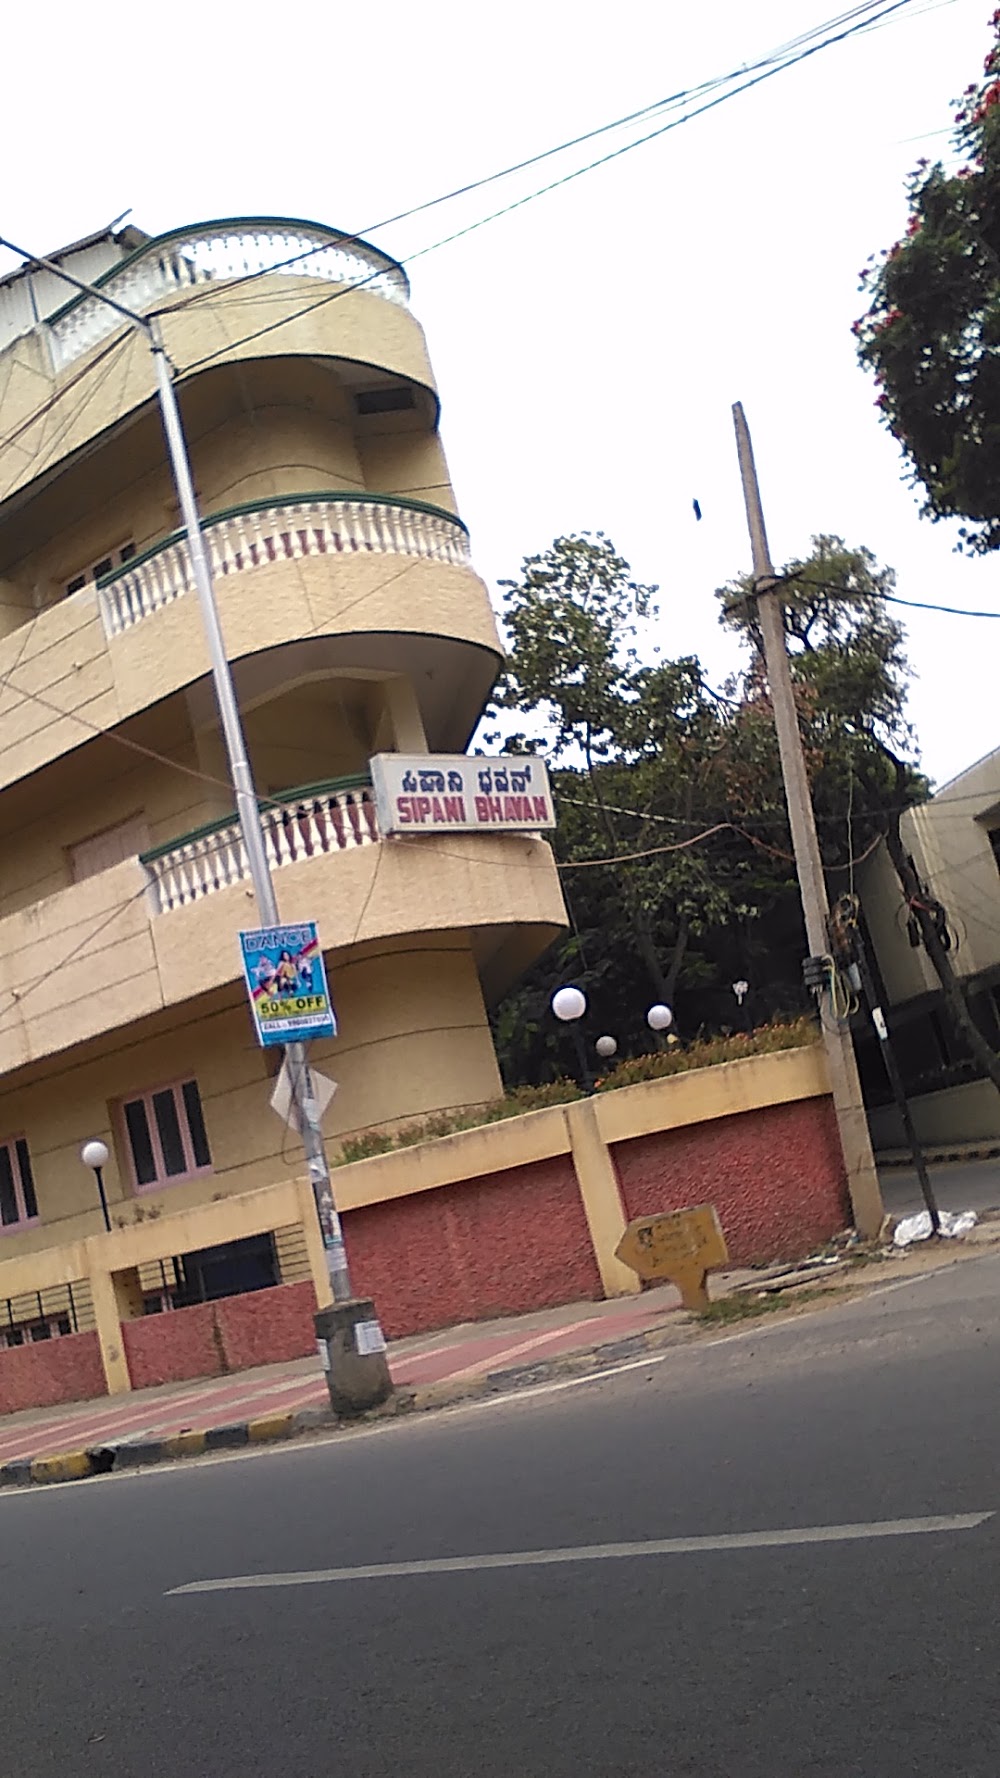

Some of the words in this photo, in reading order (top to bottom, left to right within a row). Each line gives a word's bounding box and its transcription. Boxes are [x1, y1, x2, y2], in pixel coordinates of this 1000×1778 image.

[396, 796, 467, 823] SIPANI
[475, 796, 549, 823] BHAVAN
[245, 929, 313, 952] DANCE
[261, 1001, 292, 1014] 50%
[296, 996, 323, 1009] OFF
